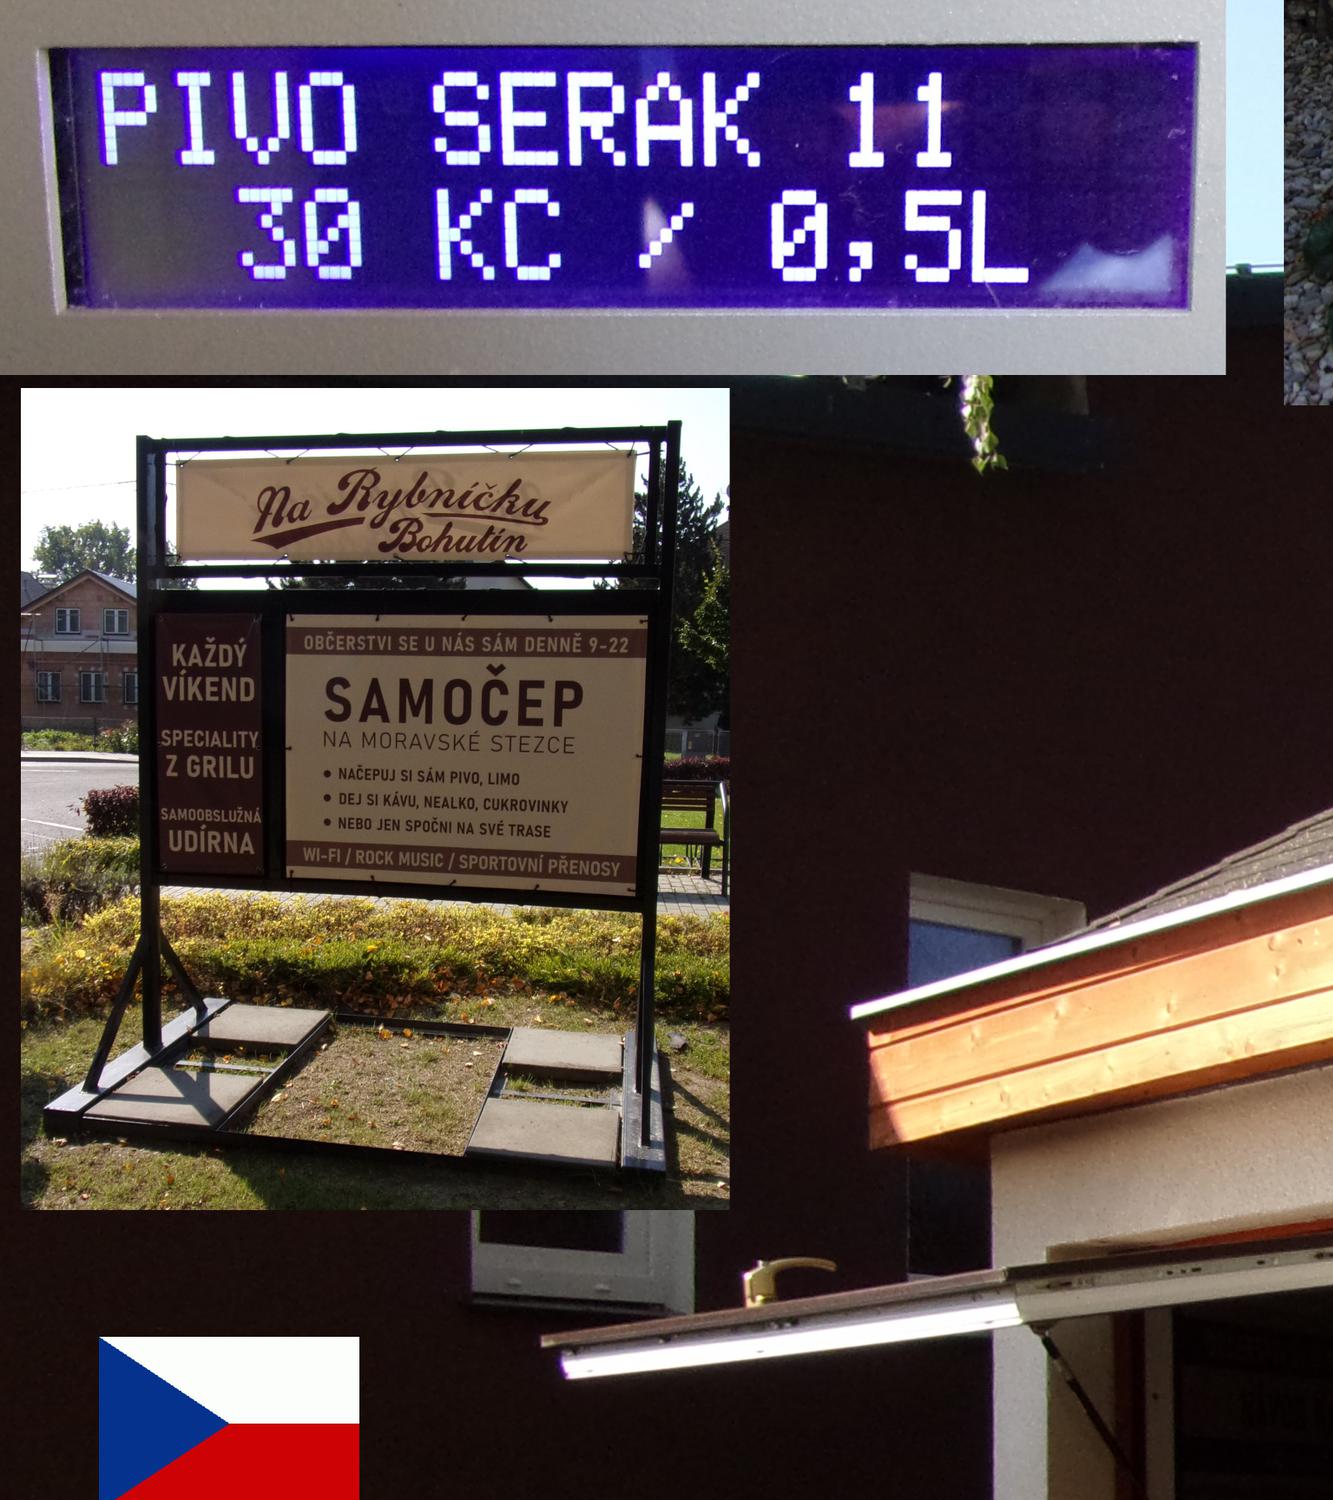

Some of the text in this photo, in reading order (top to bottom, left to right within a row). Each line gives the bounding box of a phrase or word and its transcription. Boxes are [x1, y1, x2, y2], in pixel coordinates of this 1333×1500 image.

[98, 72, 952, 168] PIVO SERAK 11
[238, 188, 1029, 284] 30 KC / 0,5L
[254, 468, 550, 534] Na Rybníčku
[378, 517, 528, 555] Bohutín
[172, 636, 247, 668] KAŽDÝ
[303, 631, 630, 654] OBČERSTVI SE U NÁS SÁM DENNĚ 9-22
[162, 669, 256, 702] VÍKEND
[324, 663, 585, 728] SAMOČEP
[160, 729, 259, 750] SPECIALITY
[322, 729, 576, 754] NA MORAVSKÉ STEZCE
[166, 753, 255, 779] Z GRILU
[338, 765, 521, 787] NAČEPUJ SI SÁM PIVO, LIMO
[160, 806, 262, 824] SAMOOBSLUŽNÁ
[338, 792, 569, 814] DEJ SI KÁVU, NEALKO, CUKROVINKY
[168, 824, 255, 855] UDÍRNA
[338, 816, 551, 838] NEBO JEN SPOČNI NA SVÉ TRASE
[303, 847, 341, 864] WI-FI
[355, 848, 395, 867] ROCK
[399, 850, 444, 868] MUSIC
[459, 853, 544, 874] SPORTOVNÍ
[548, 855, 621, 878] PŘENOSY
